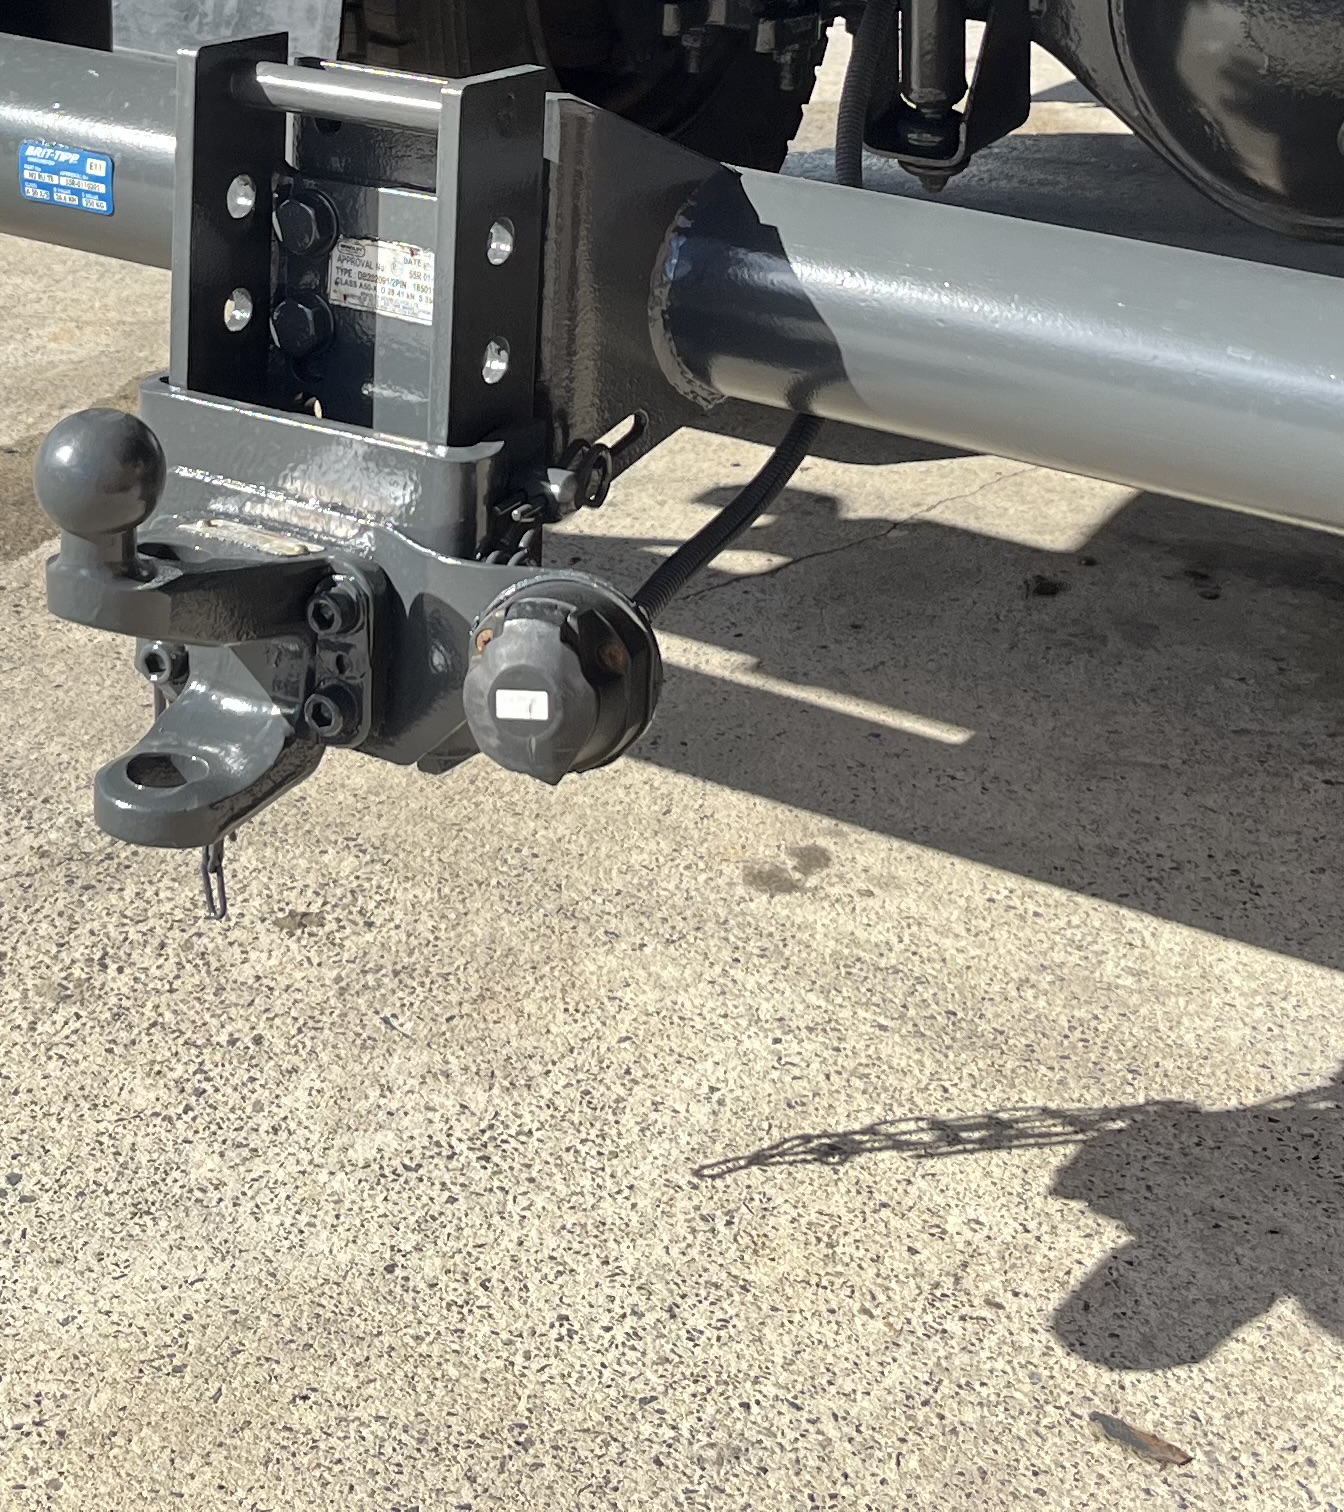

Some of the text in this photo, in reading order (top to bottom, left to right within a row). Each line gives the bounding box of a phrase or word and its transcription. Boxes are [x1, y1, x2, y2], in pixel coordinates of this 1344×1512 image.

[337, 254, 374, 270] APPROVAL
[403, 256, 422, 267] DATE
[336, 266, 353, 278] TYPE
[335, 277, 358, 288] CLASS
